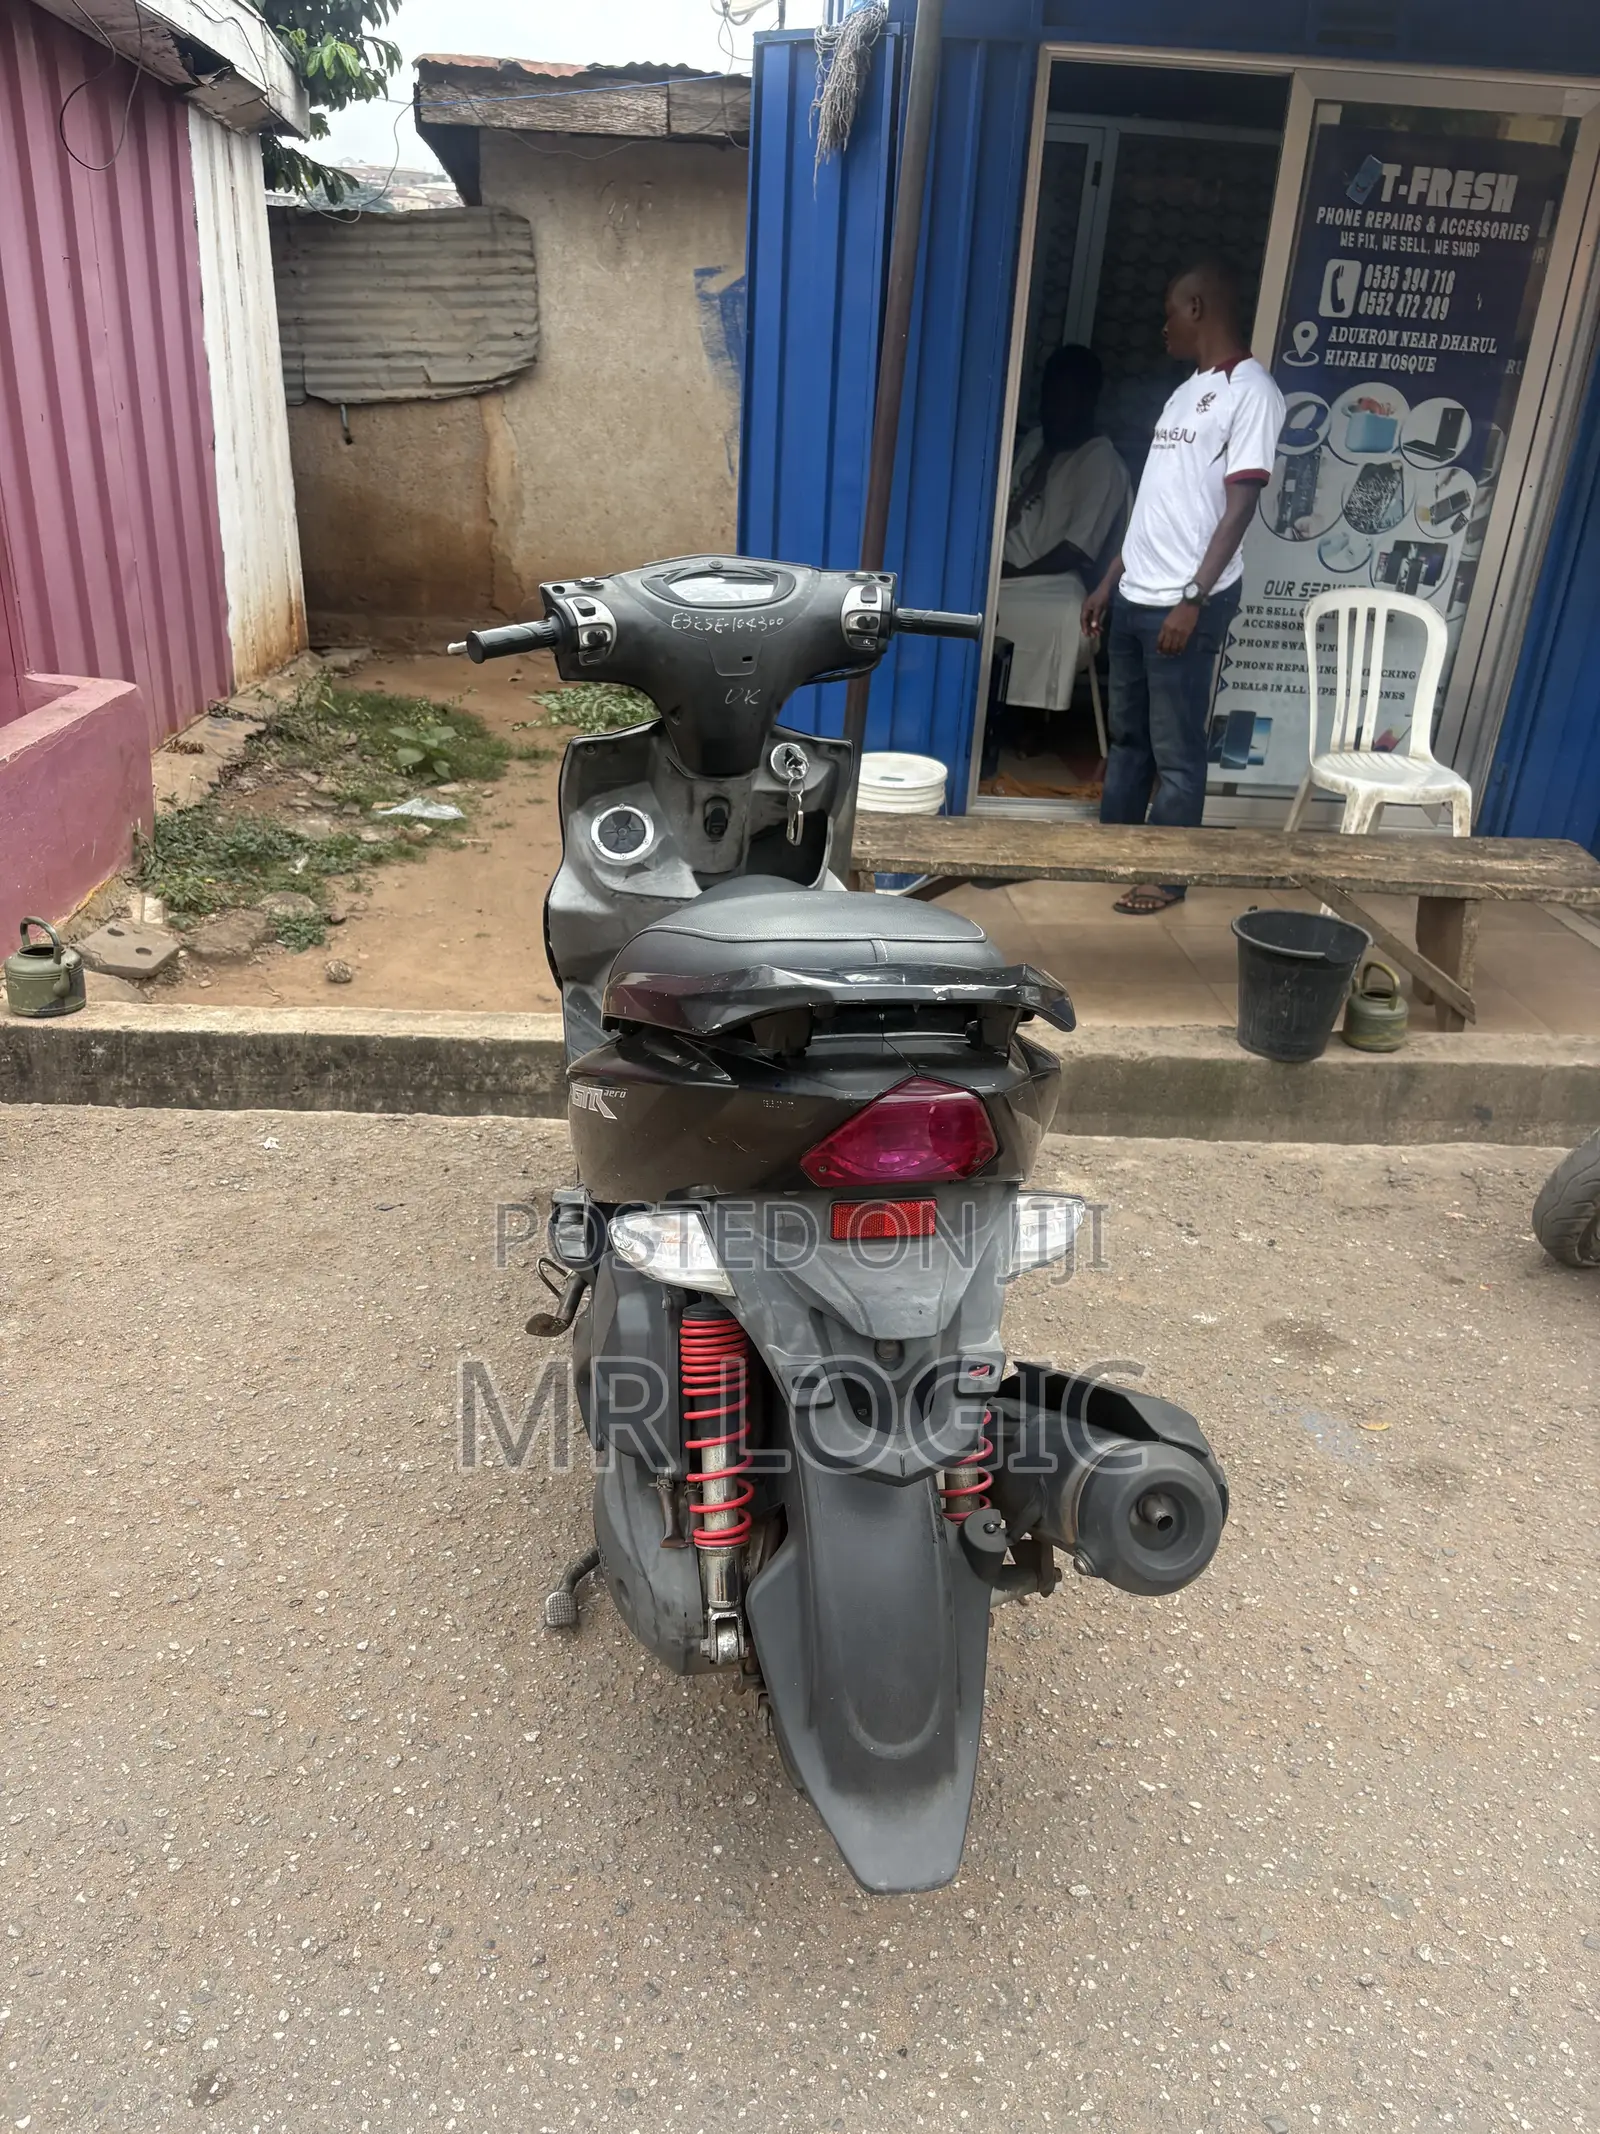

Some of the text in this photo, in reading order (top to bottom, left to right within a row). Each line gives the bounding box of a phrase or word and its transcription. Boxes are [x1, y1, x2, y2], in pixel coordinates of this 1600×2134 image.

[1380, 163, 1519, 213] T-FRESH
[1316, 207, 1530, 242] PHONE REPAIRS & ACCESSORIES
[1340, 231, 1480, 258] WE FIX, WE SELL, WE SWAP
[1363, 263, 1400, 290] 0535
[1402, 267, 1430, 293] 394
[1358, 290, 1450, 320] 0552 472 289
[1328, 326, 1497, 354] ADUKROM NEAR DHARUL
[1324, 350, 1437, 374] HIJRAH MOSQUE
[1263, 580, 1296, 596] OUR
[1246, 605, 1264, 615] WE
[1265, 606, 1297, 617] SELL
[1242, 619, 1326, 633] ACCESSORS
[1237, 637, 1279, 650] PHONE
[1235, 659, 1274, 672] PHONE
[1231, 681, 1268, 693] DEALS
[1269, 683, 1284, 694] IN
[1284, 684, 1306, 695] ALL
